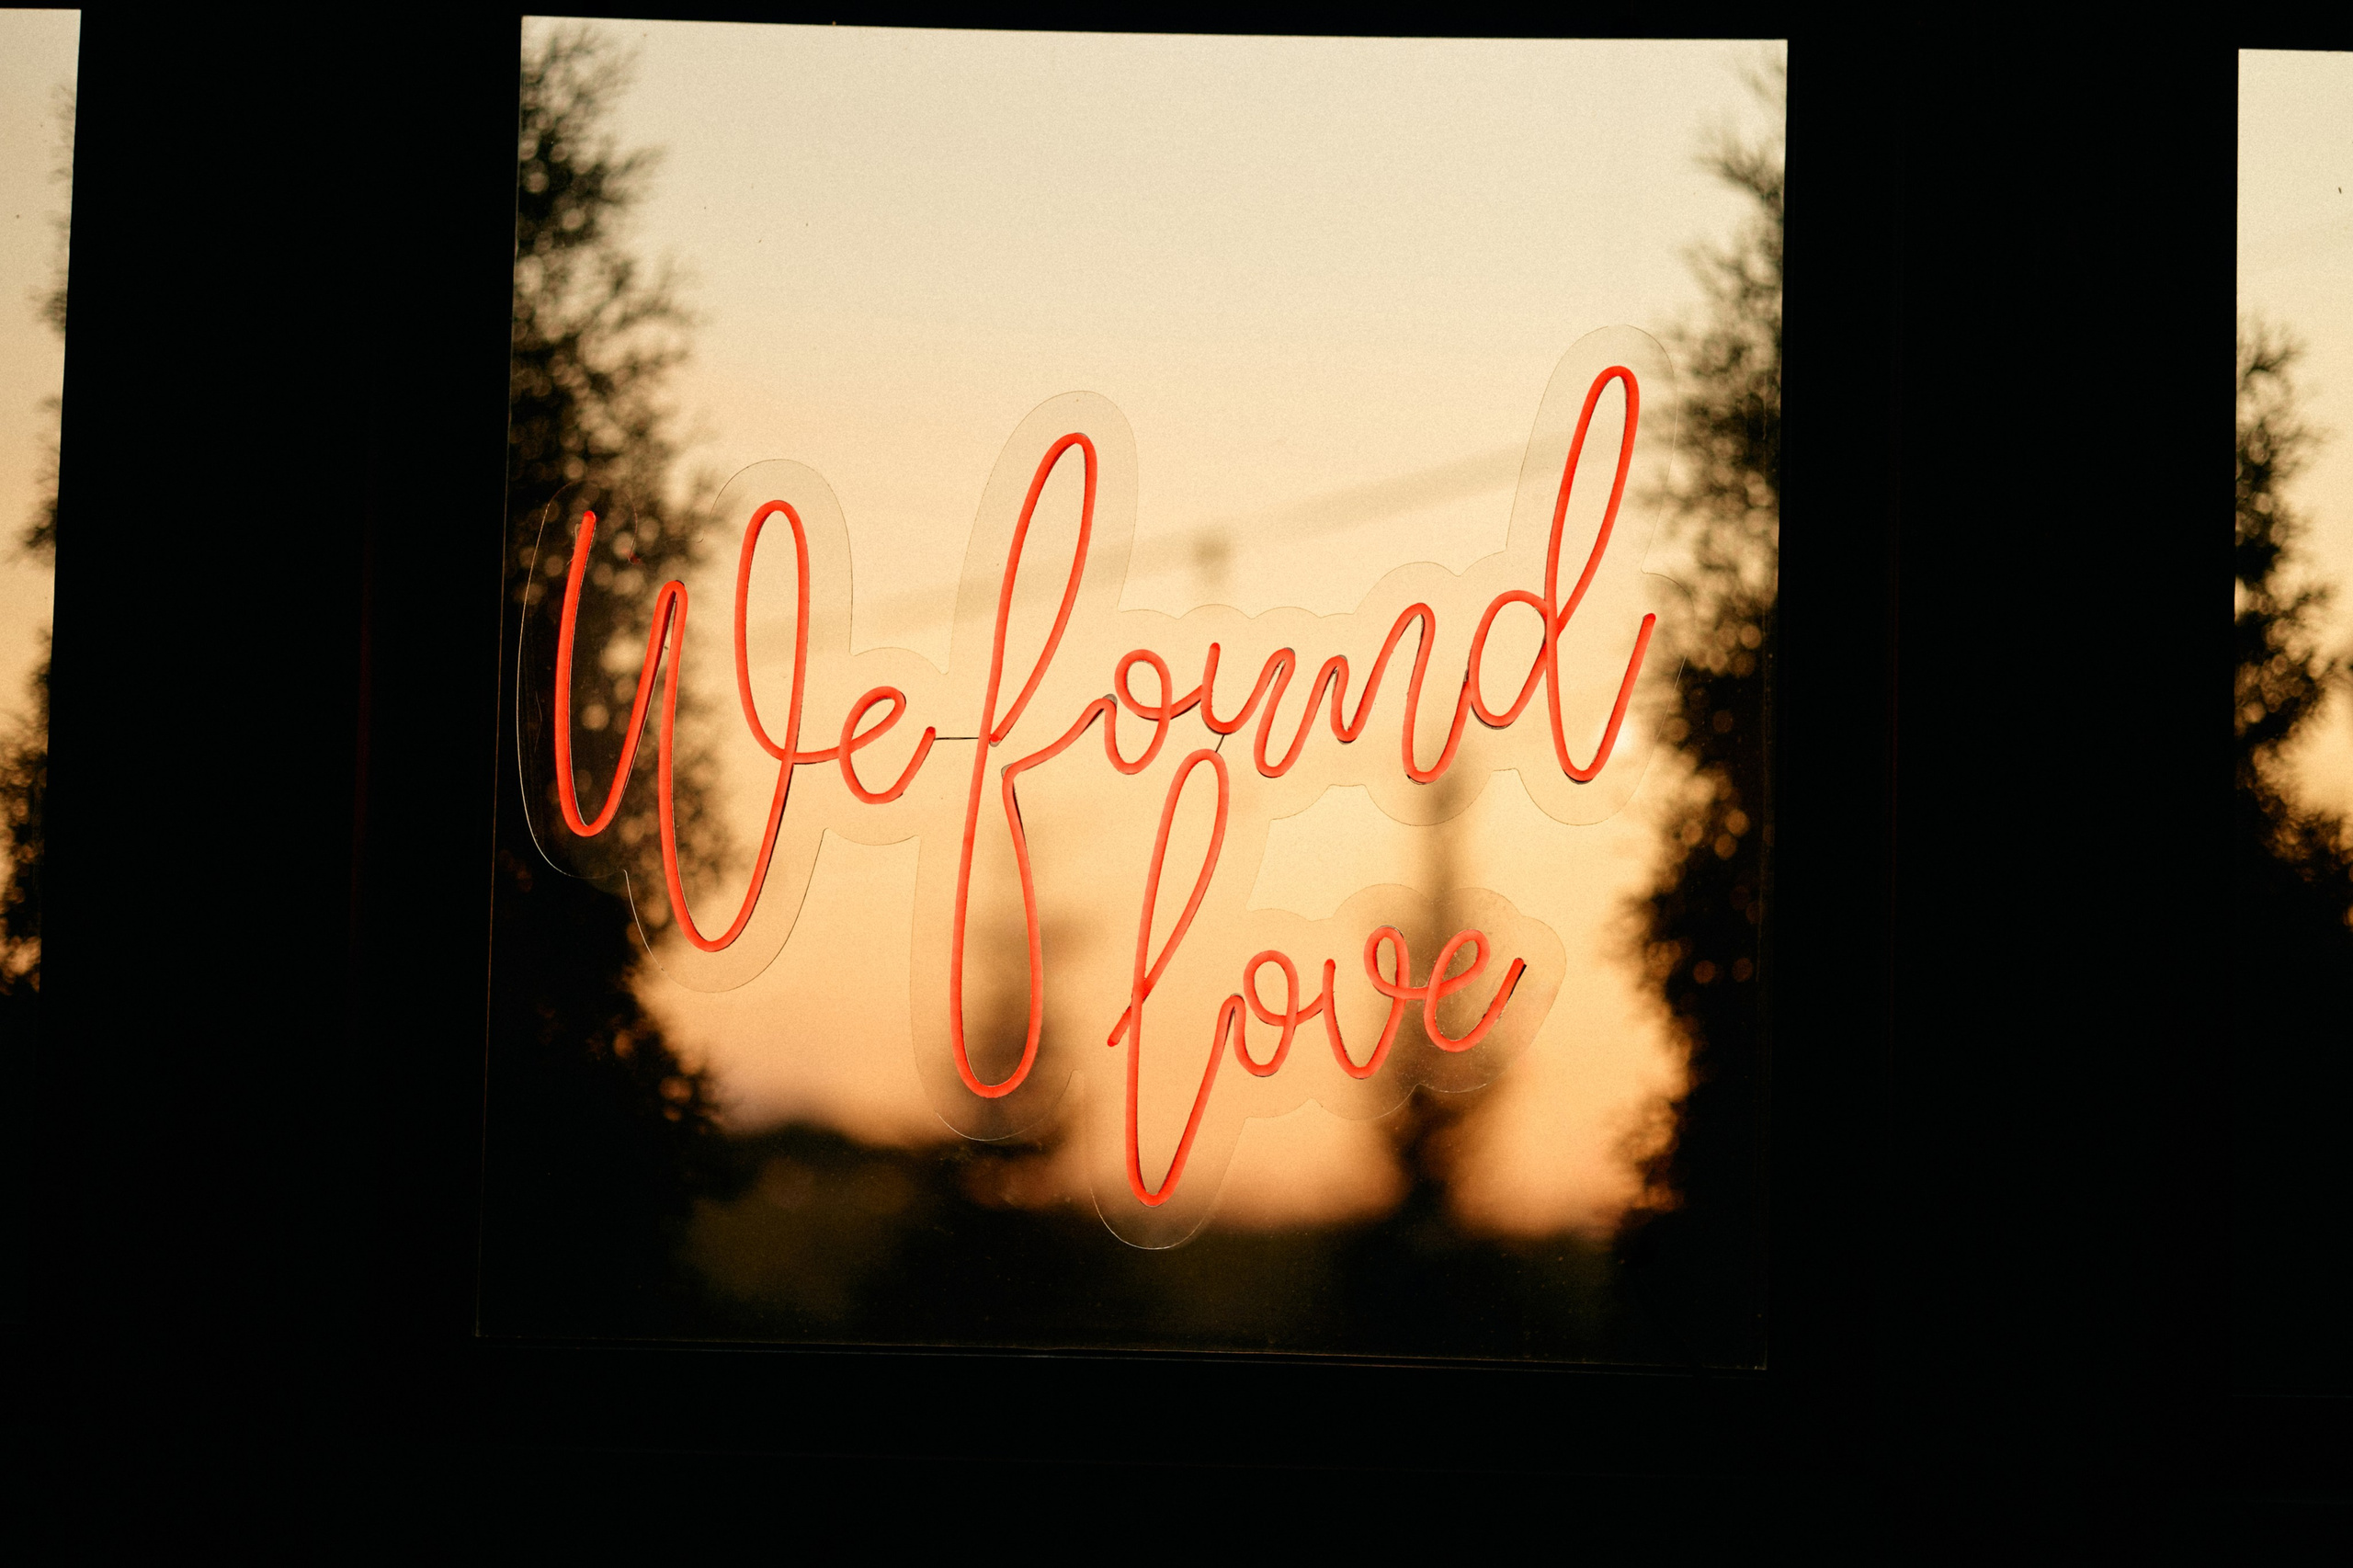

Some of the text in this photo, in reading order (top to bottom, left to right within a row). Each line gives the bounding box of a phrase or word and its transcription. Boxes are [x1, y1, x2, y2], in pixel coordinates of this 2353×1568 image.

[555, 366, 1657, 1098] We found
[1107, 749, 1526, 1206] love
